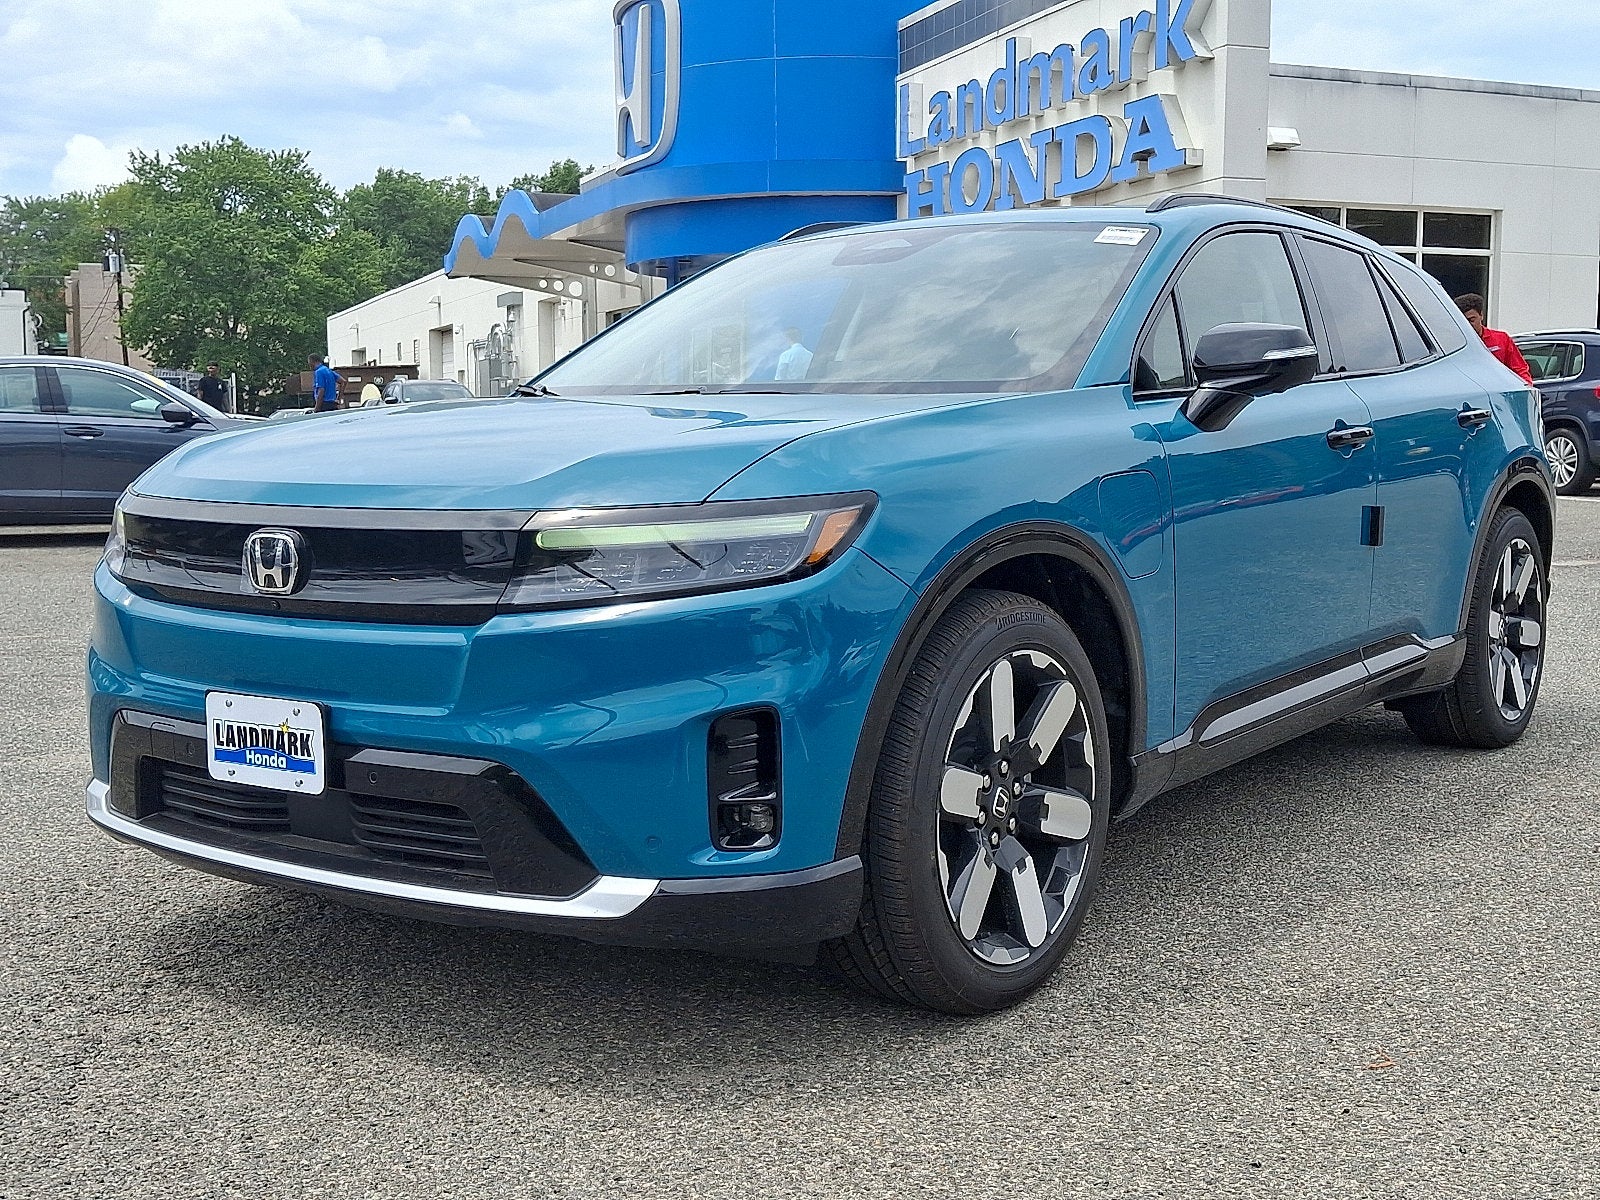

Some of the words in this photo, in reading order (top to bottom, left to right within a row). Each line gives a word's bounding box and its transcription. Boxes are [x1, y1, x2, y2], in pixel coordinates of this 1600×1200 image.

[900, 0, 1198, 158] Landmark
[903, 94, 1187, 218] HONDA
[995, 611, 1047, 630] BRIDGESTONE
[214, 720, 313, 758] LANDMARK
[245, 749, 287, 769] Honda
